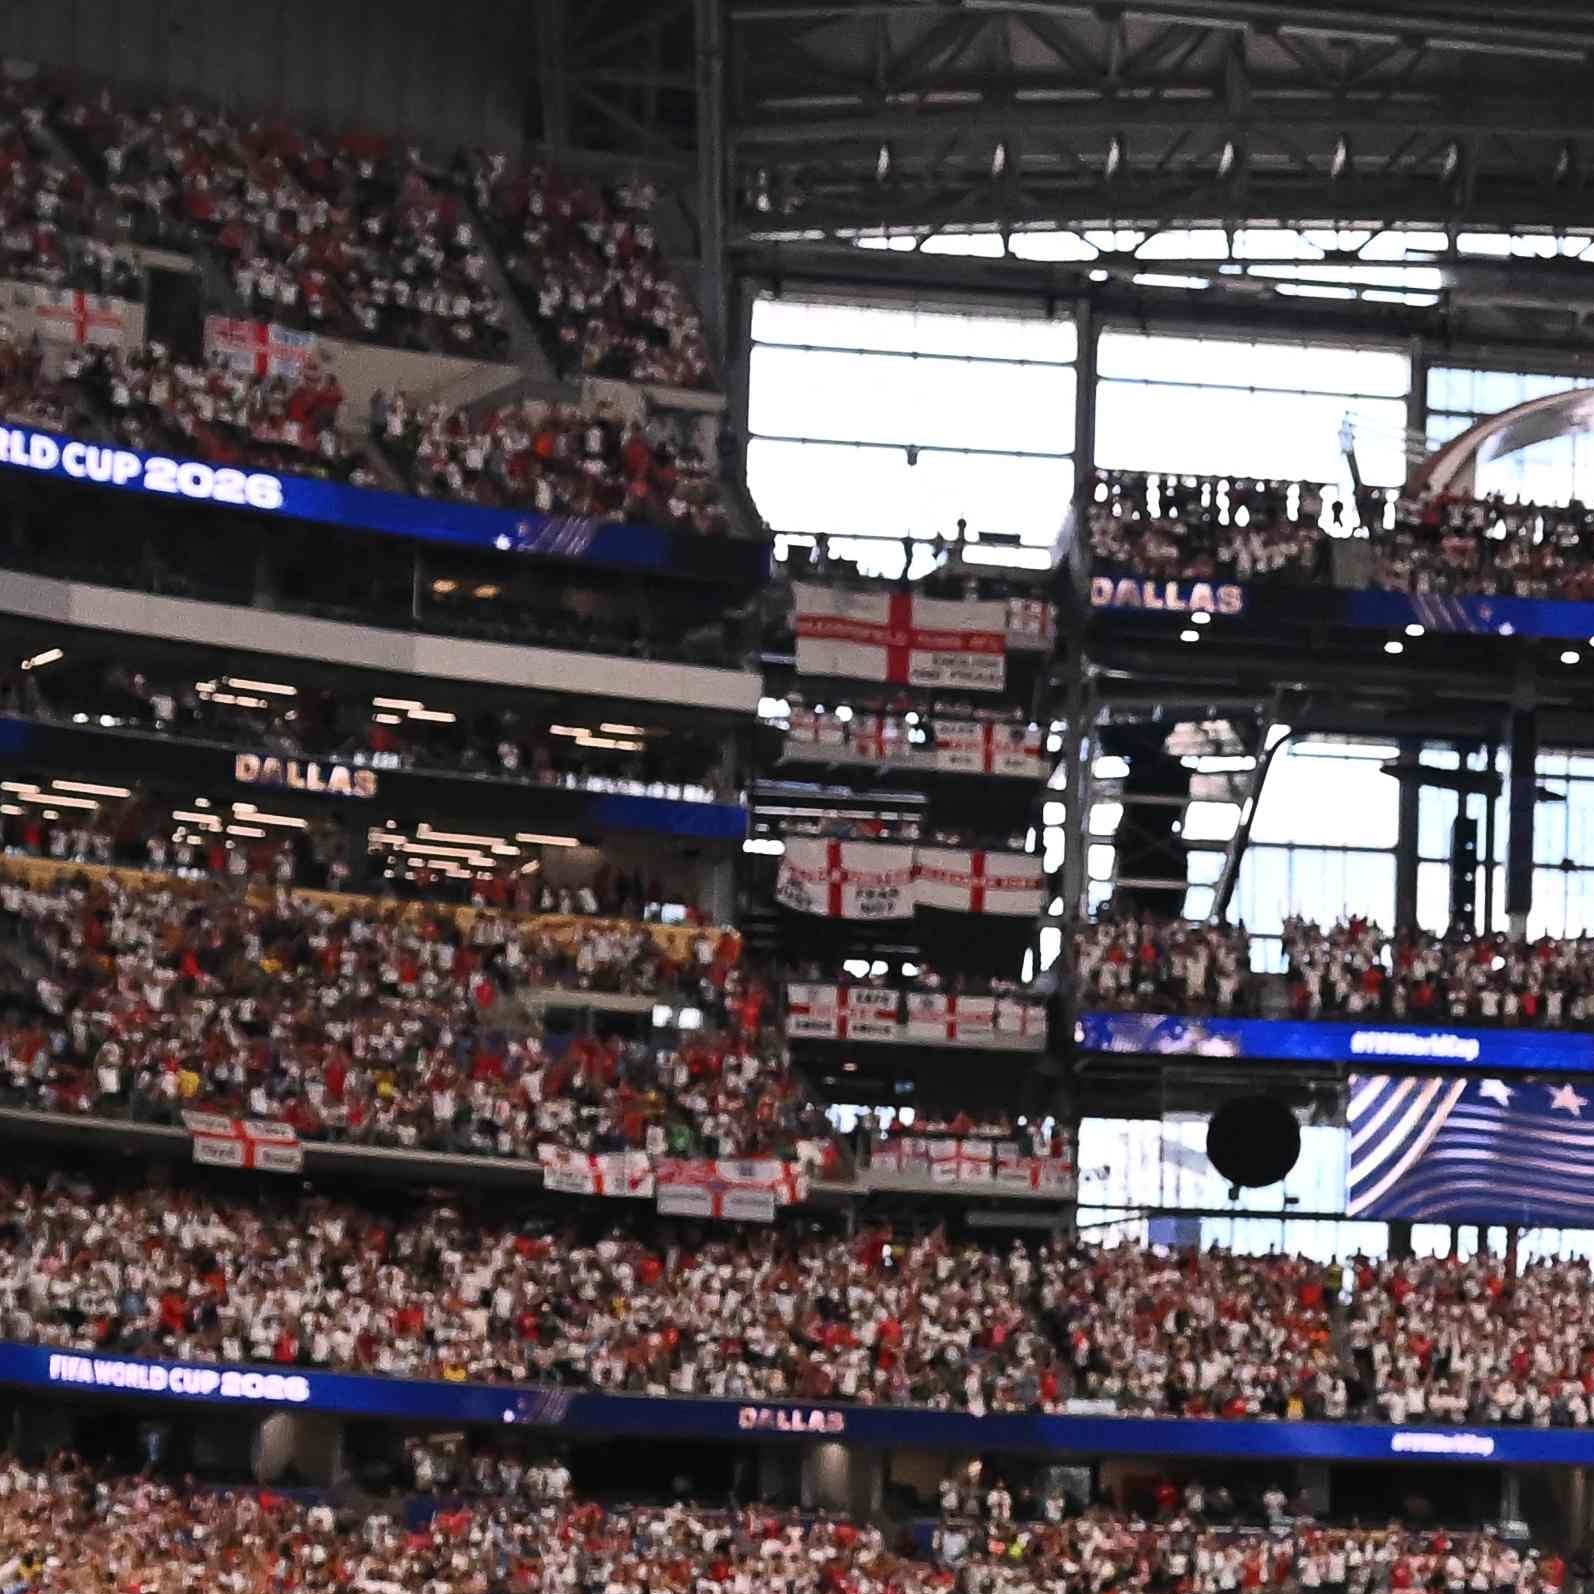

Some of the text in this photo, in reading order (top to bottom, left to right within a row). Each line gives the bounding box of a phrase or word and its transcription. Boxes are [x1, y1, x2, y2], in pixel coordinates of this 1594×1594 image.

[62, 441, 142, 485] CUP
[144, 456, 283, 509] 2026
[1091, 577, 1243, 614] DALLAS
[234, 753, 378, 796] DALLAS
[94, 1359, 169, 1392] WORLD
[168, 1367, 221, 1395] CUP
